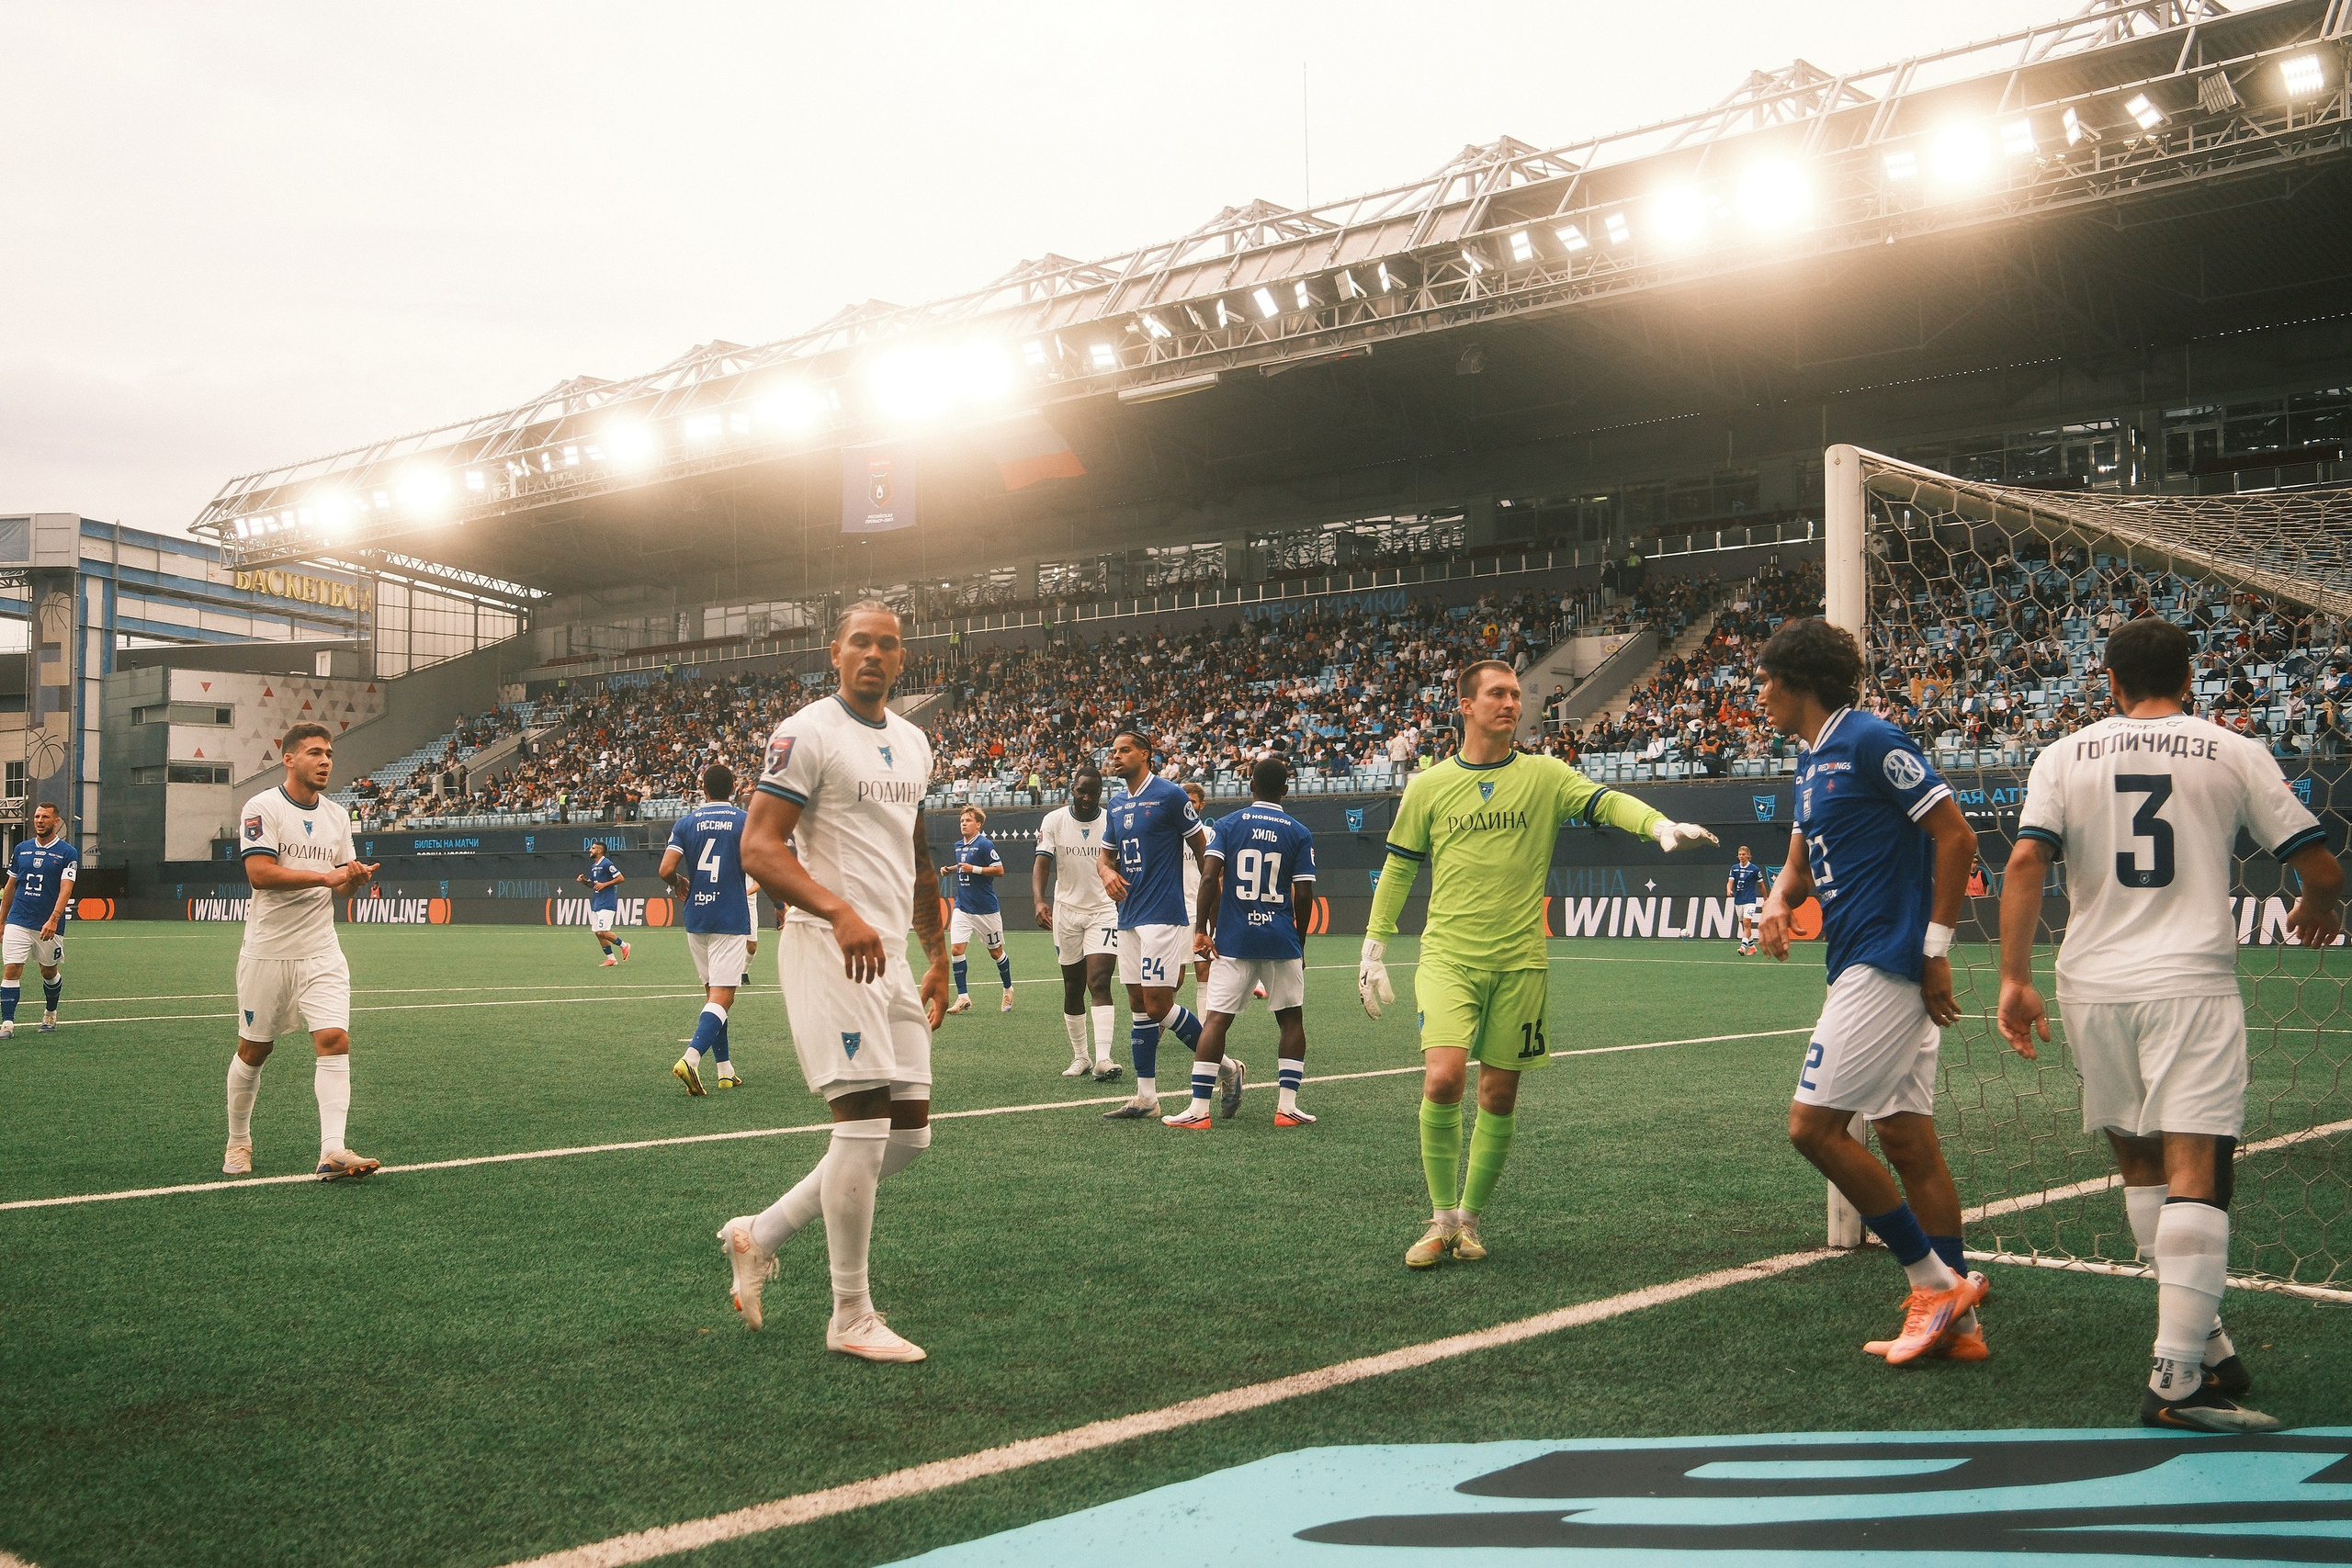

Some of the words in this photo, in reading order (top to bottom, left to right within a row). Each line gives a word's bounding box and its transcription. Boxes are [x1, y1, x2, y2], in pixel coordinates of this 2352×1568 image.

[2076, 731, 2219, 761] ГОГЛИЧИДЗЕ
[858, 781, 922, 804] РОДИН
[696, 820, 733, 831] ГАССАМА
[1251, 814, 1292, 826] НОВИКОМ
[1448, 811, 1528, 834] РОДИНА
[2115, 774, 2176, 888] 3
[414, 840, 442, 849] БИЛЕТЫ
[444, 839, 454, 848] НА
[455, 838, 480, 848] МАТЧИ
[1251, 829, 1278, 842] ХИЛЬ
[278, 842, 334, 863] РОДИНА
[697, 838, 721, 883] 4
[1066, 846, 1101, 857] РОДИН
[1236, 849, 1284, 904] 91
[695, 891, 719, 904] rbpi
[195, 898, 252, 921] WINLINE
[356, 898, 428, 923] WINLINE
[557, 898, 645, 925] WINNE
[1248, 910, 1275, 925] rbpi
[599, 919, 604, 928] 5
[987, 931, 1001, 945] 11
[1142, 957, 1165, 981] 24
[1800, 1042, 1825, 1091] 2
